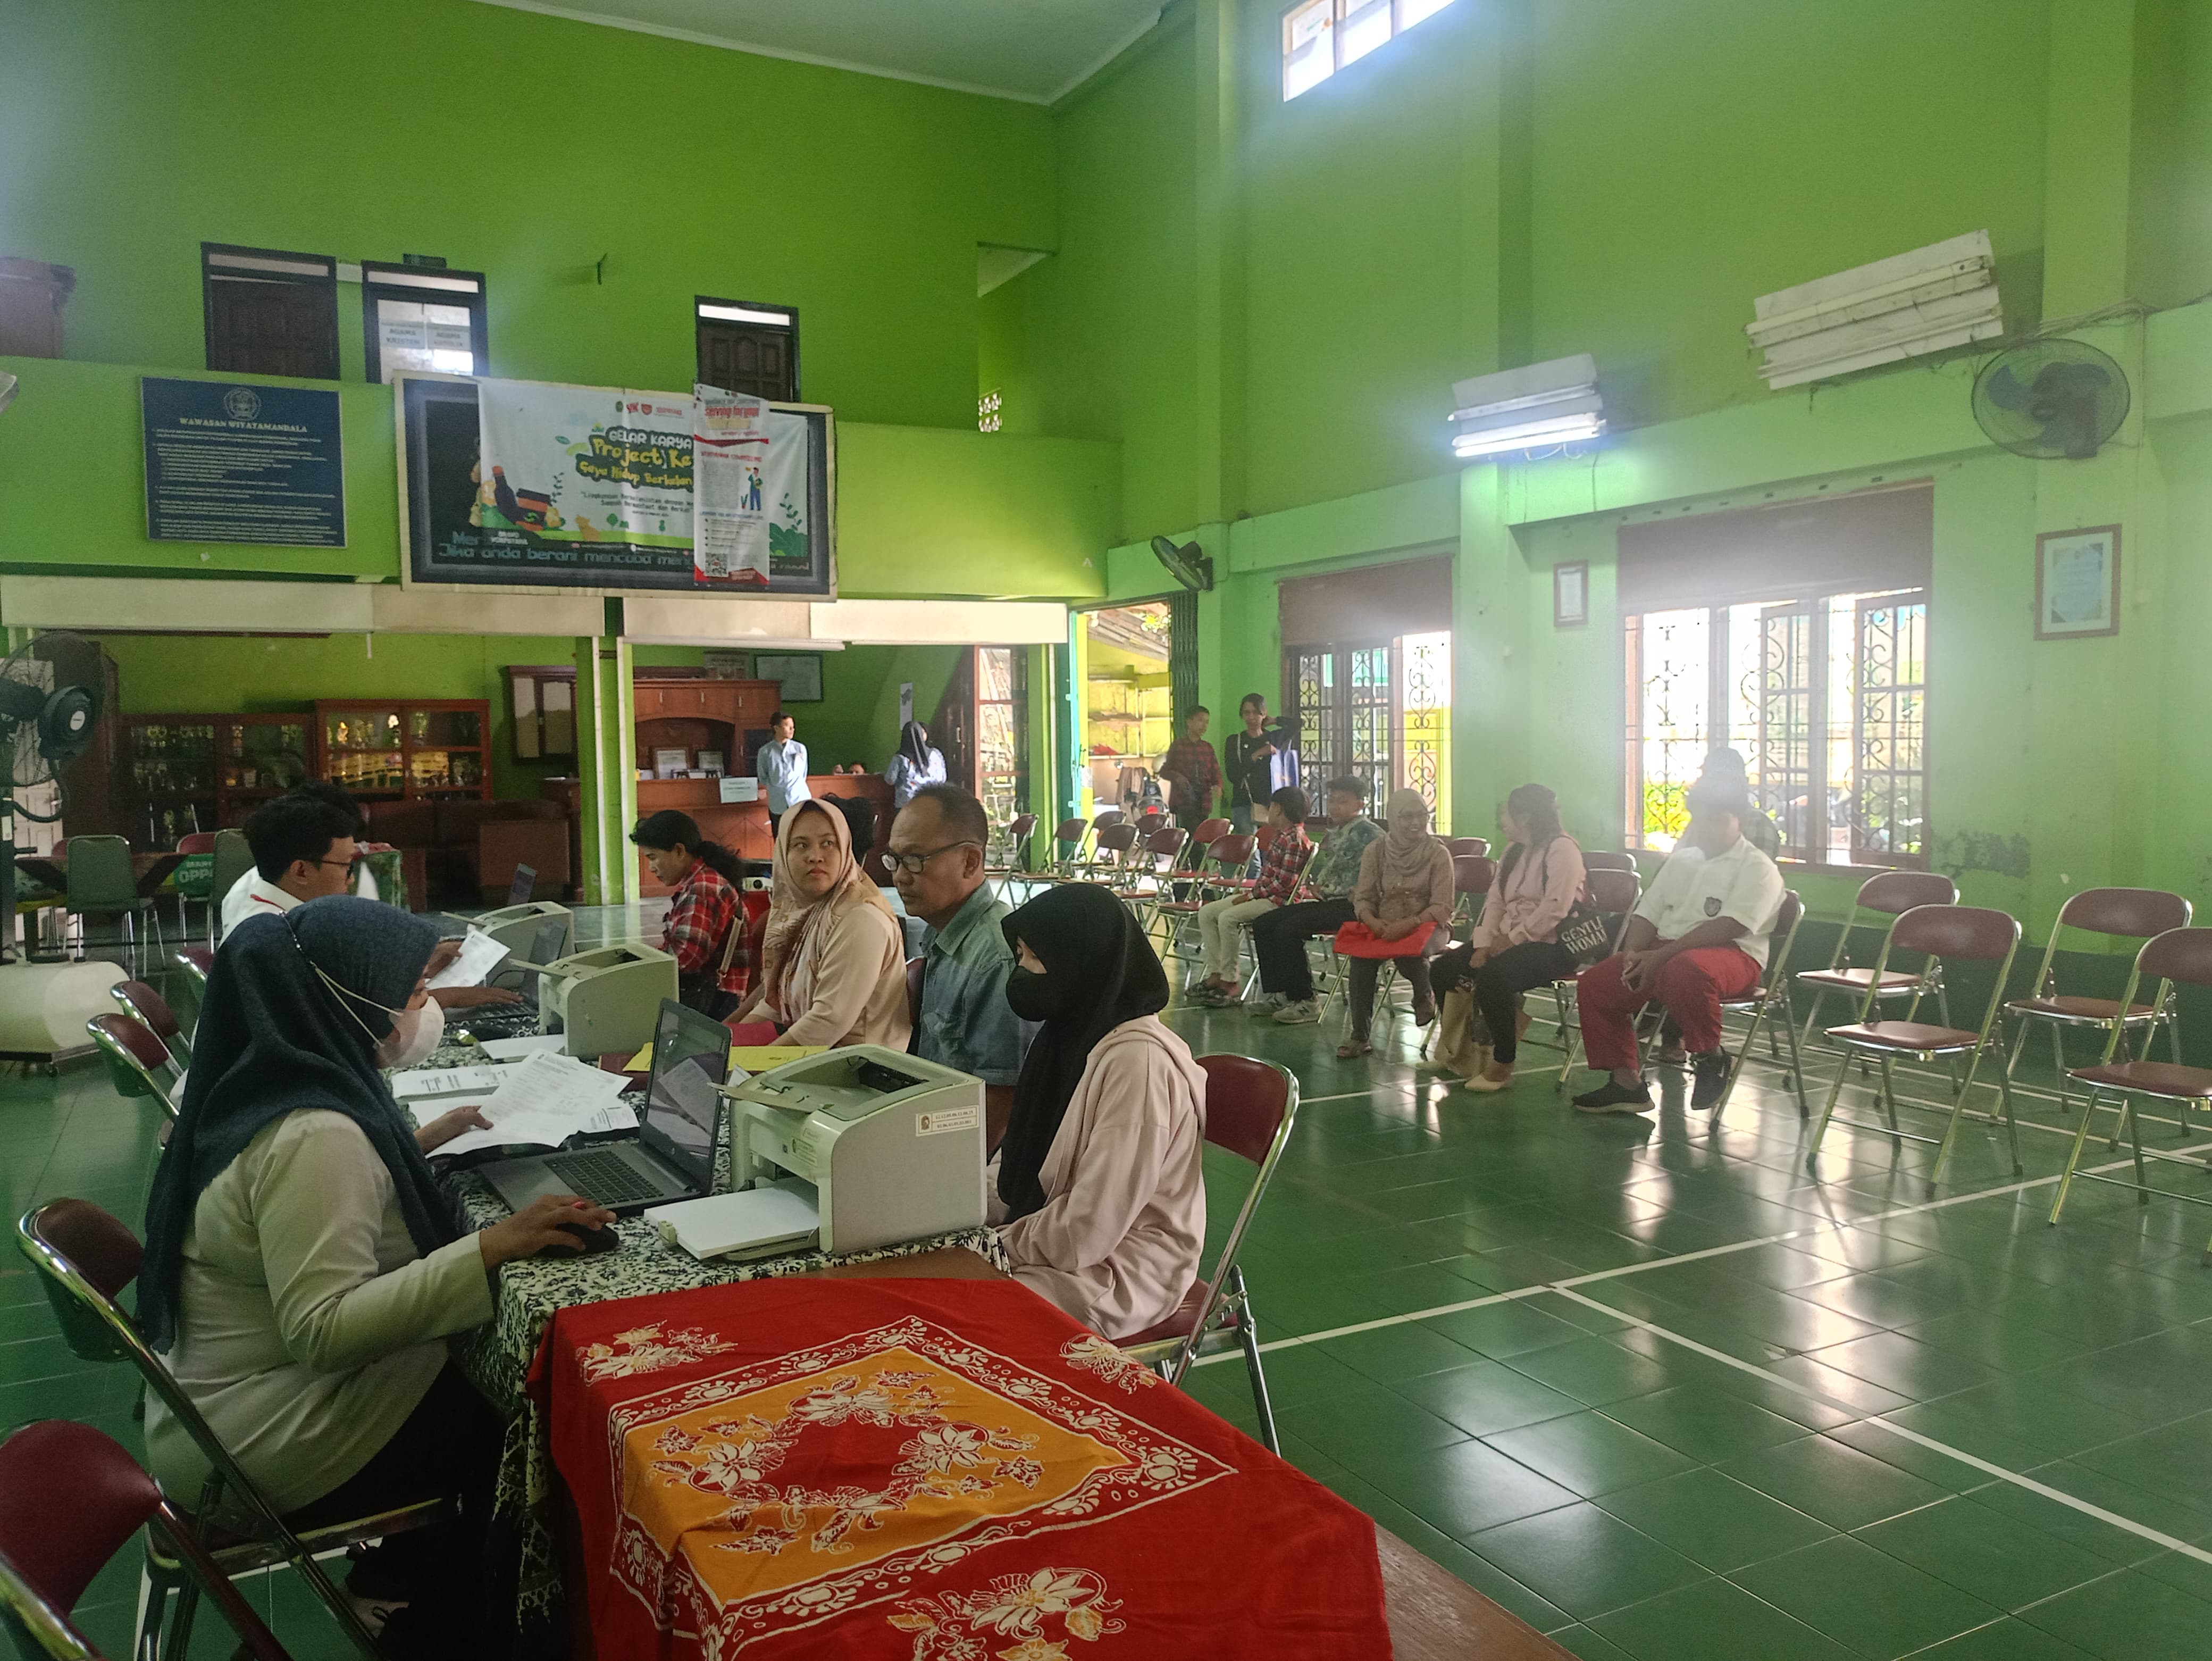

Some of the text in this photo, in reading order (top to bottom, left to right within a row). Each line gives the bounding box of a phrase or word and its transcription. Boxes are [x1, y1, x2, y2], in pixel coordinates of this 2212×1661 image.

[180, 417, 227, 427] WAWASAN
[608, 430, 692, 449] GELAR KARYA
[592, 438, 663, 468] Project
[579, 461, 608, 478] Gaya
[612, 466, 640, 486] Hidup
[481, 546, 521, 559] anda
[527, 547, 578, 562] berani
